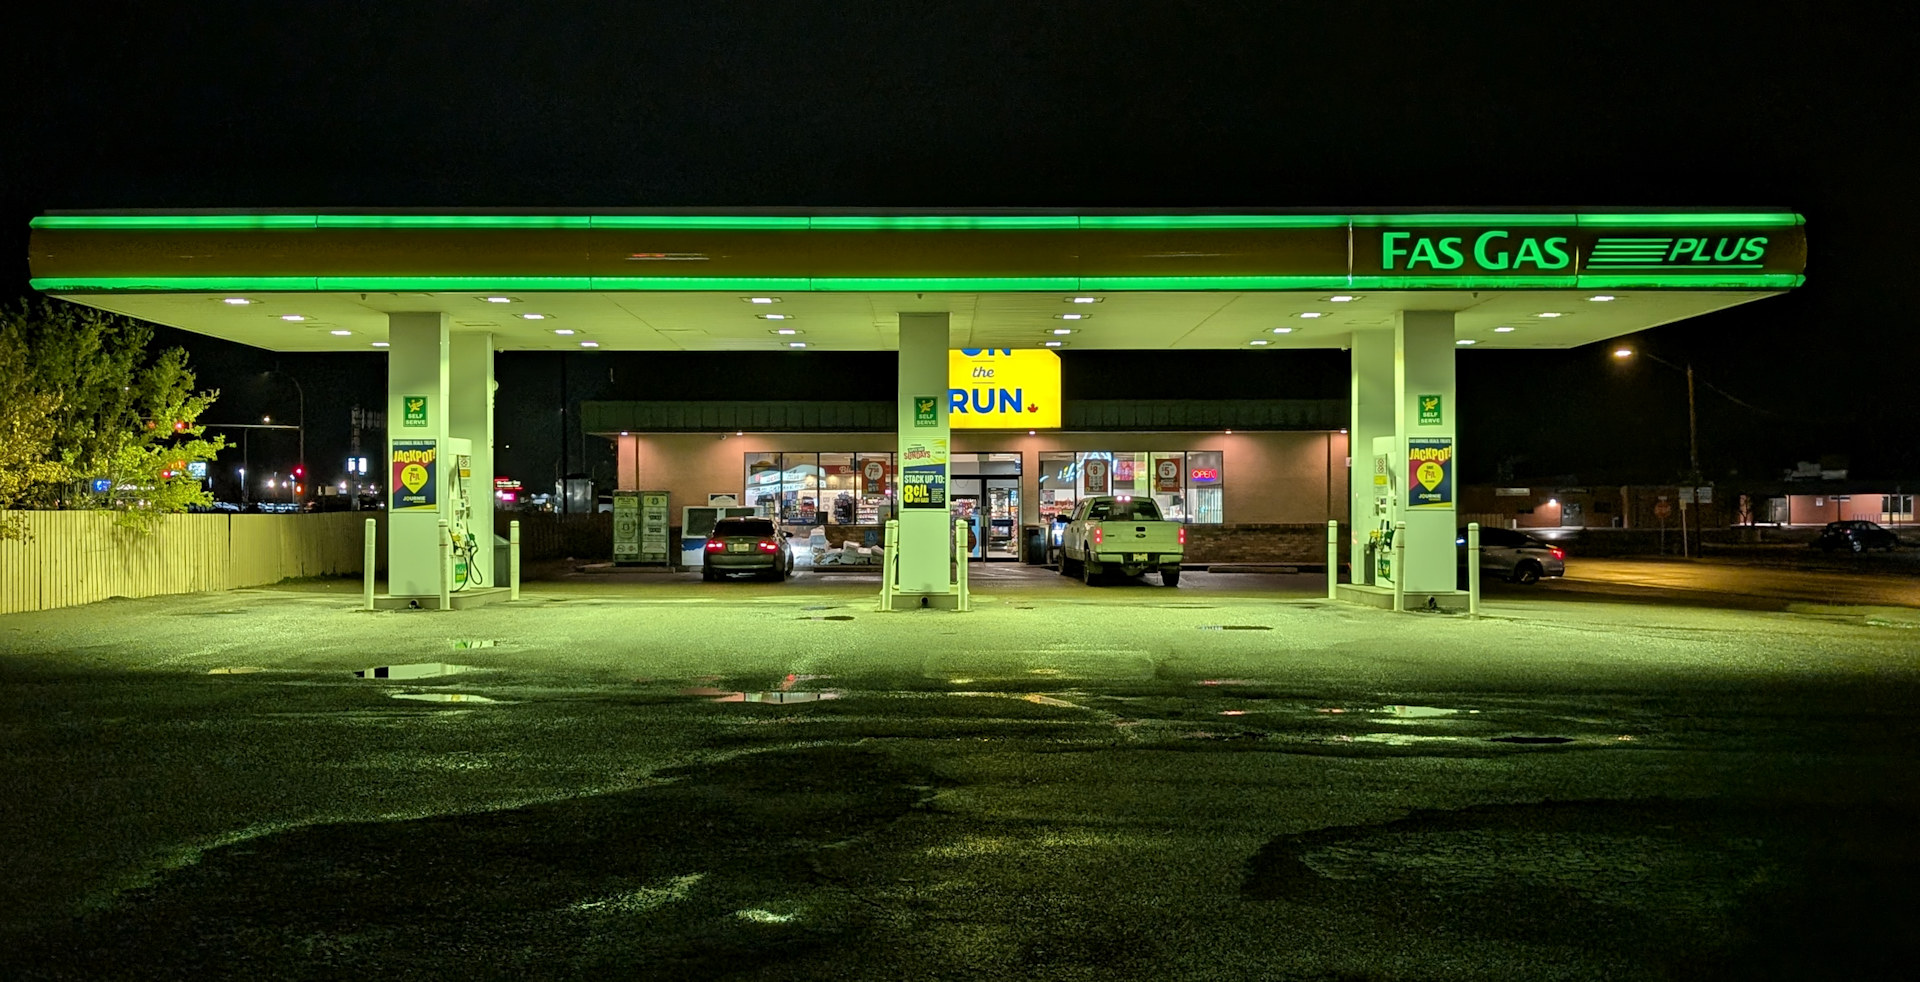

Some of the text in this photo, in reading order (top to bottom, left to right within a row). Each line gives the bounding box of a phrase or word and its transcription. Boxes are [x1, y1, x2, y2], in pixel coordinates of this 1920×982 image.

[1669, 237, 1768, 261] PLUS
[972, 366, 995, 378] the
[393, 448, 436, 463] JACKPOT!
[903, 451, 931, 460] SUNDAYS
[1409, 445, 1452, 461] JACKPOT!
[904, 475, 945, 484] STACK UP TO:
[1192, 469, 1217, 479] OPEN
